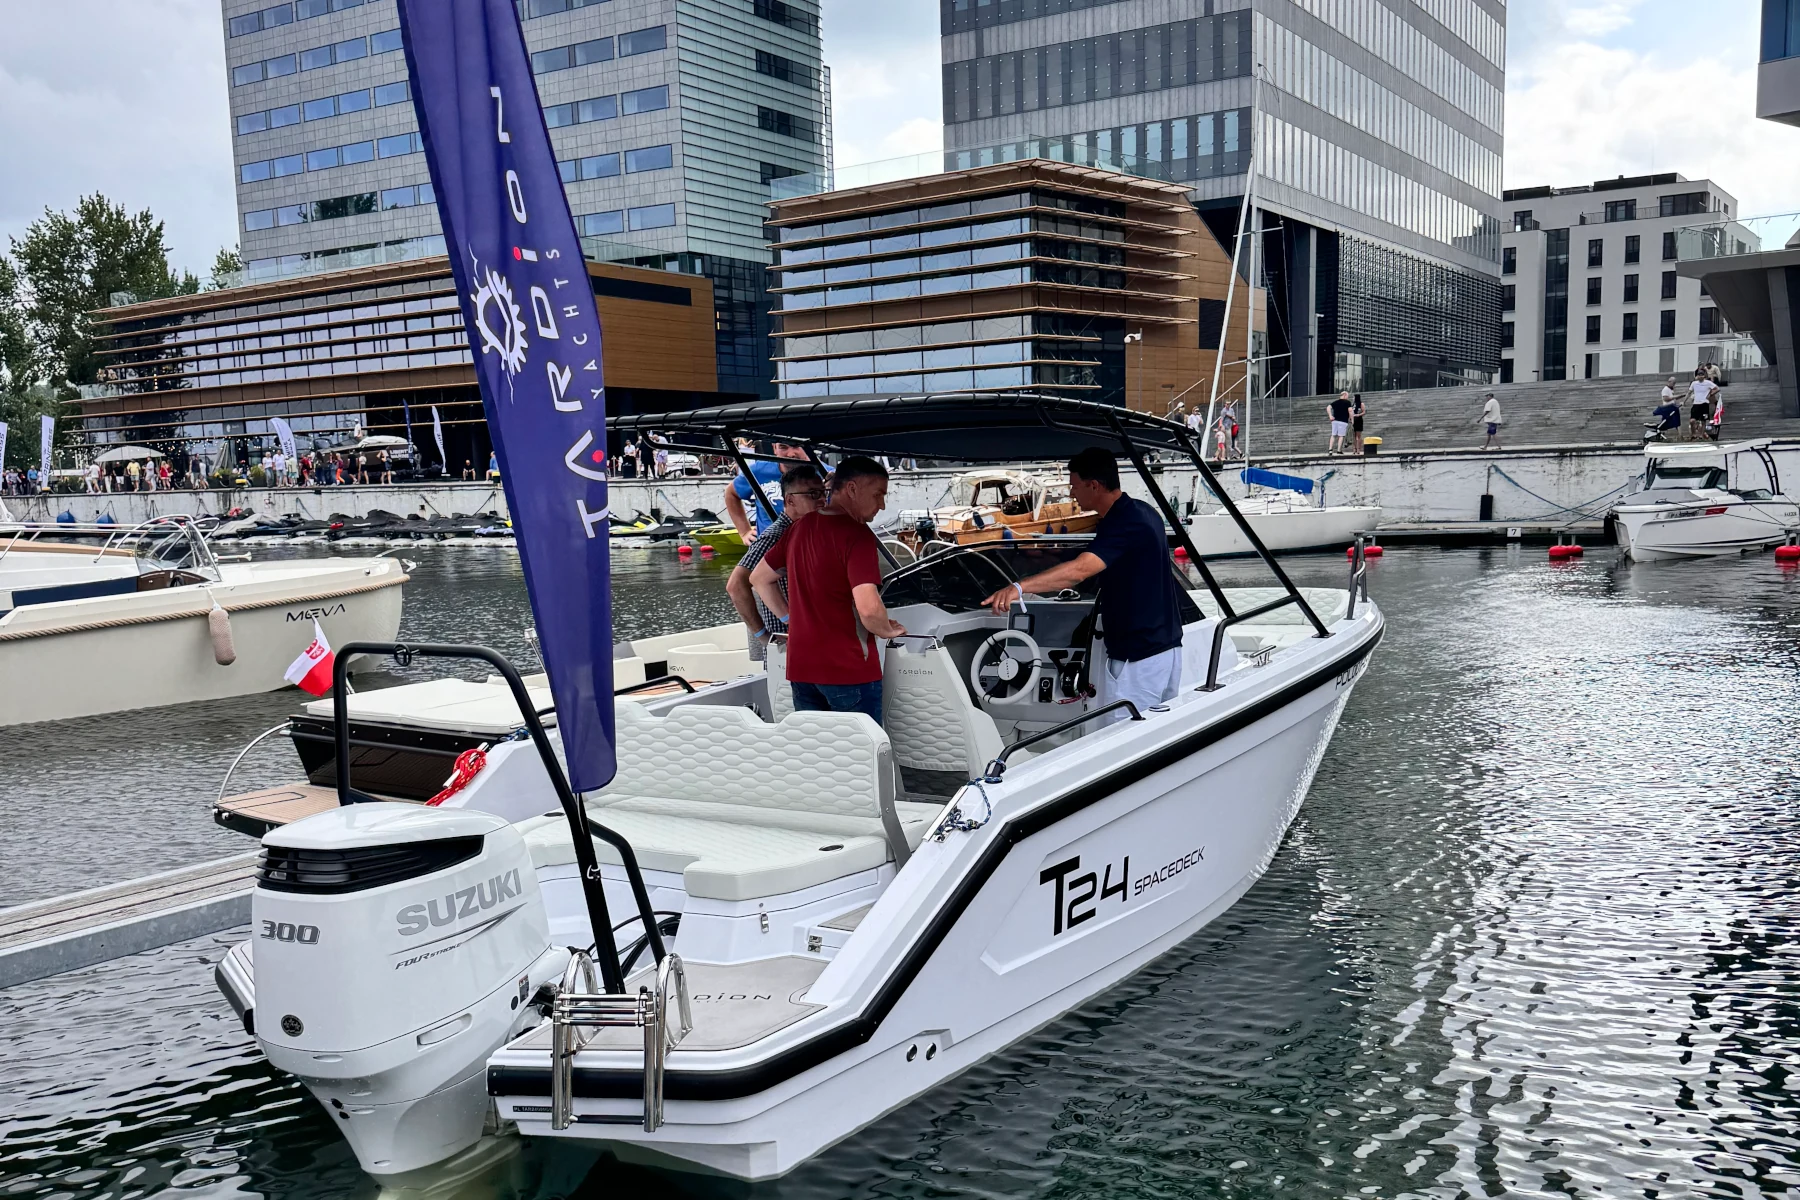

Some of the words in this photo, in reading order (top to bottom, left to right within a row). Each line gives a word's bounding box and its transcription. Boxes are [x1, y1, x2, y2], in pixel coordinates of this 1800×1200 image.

[546, 249, 603, 400] YACHTS
[286, 603, 346, 622] MEVA
[396, 868, 522, 936] SUZUKI
[1039, 854, 1130, 936] T24
[1134, 846, 1205, 896] SPACEDECK
[260, 919, 320, 945] 300
